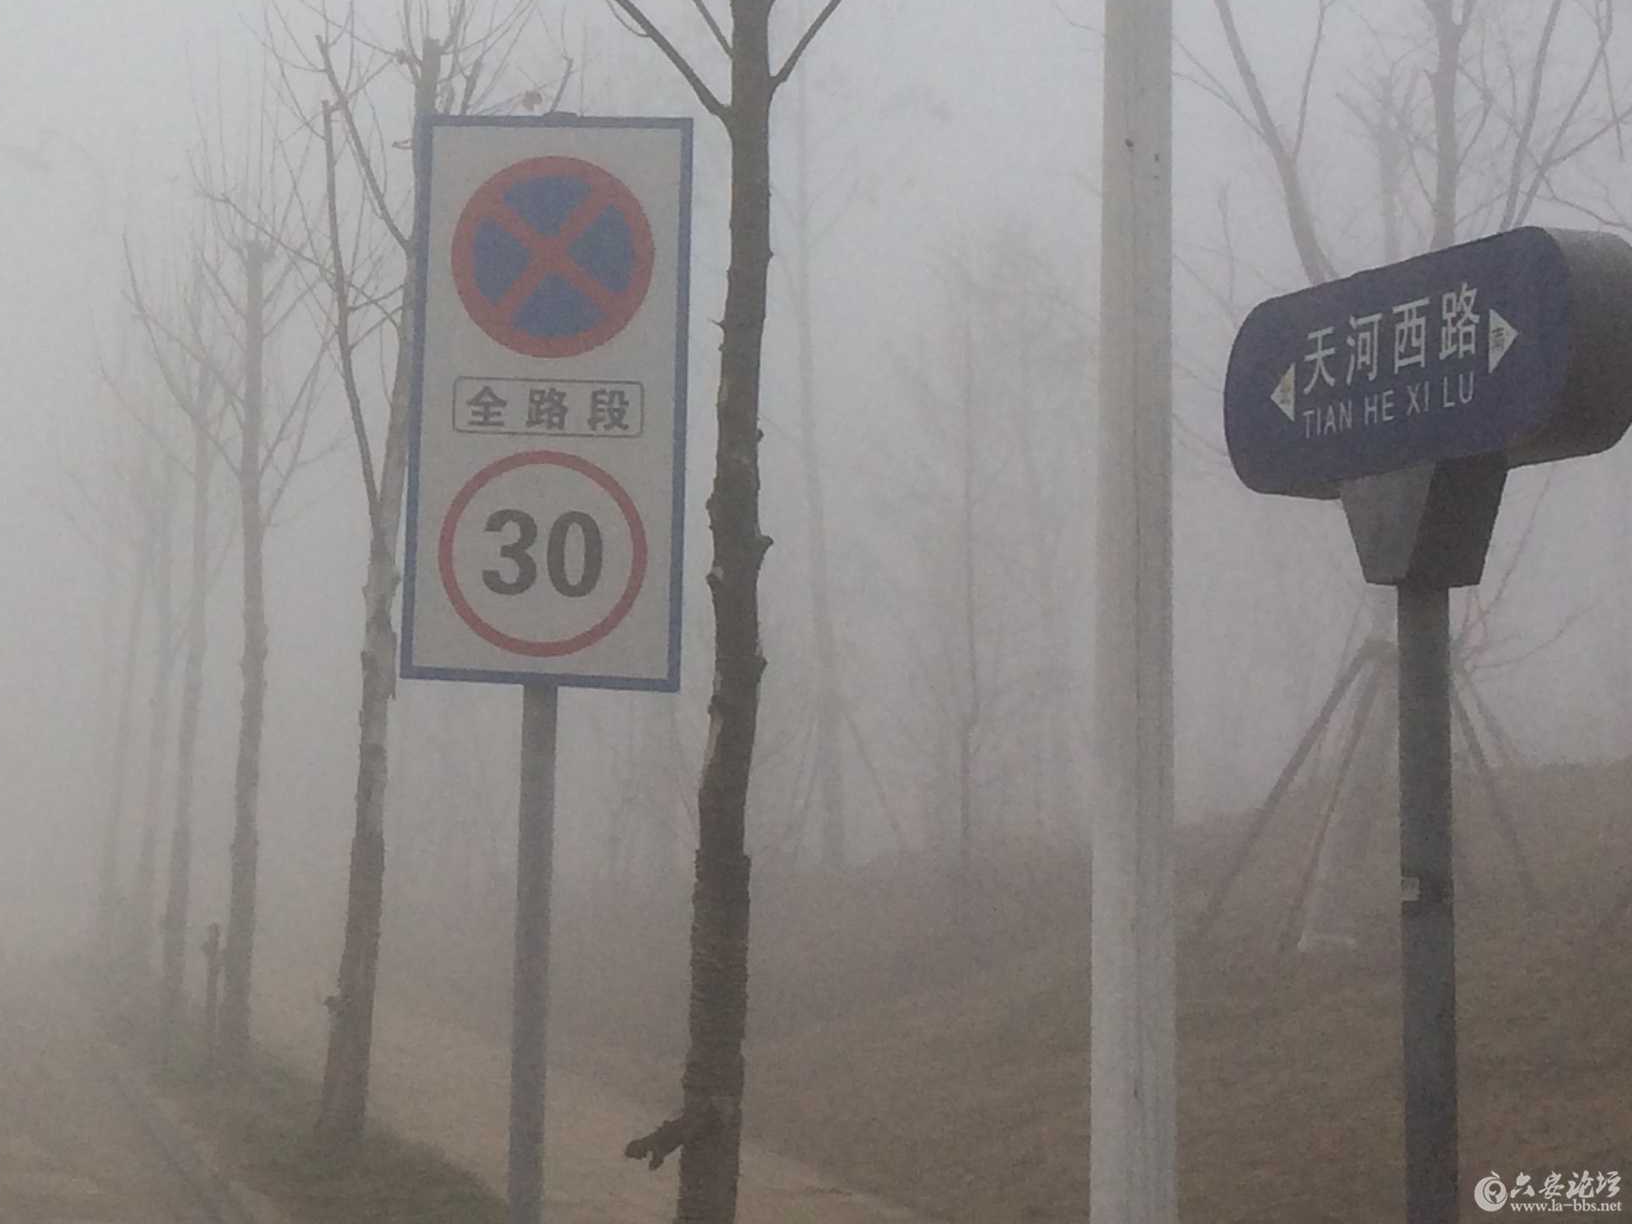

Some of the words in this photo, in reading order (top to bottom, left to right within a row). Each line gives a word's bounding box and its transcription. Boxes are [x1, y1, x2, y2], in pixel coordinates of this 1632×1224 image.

[1303, 282, 1480, 394] 天河西路
[466, 386, 630, 431] 全路段
[1303, 400, 1353, 439] TIAN
[1364, 390, 1395, 424] HE
[1406, 380, 1430, 416] XI
[1443, 371, 1475, 408] LU
[481, 509, 603, 597] 30
